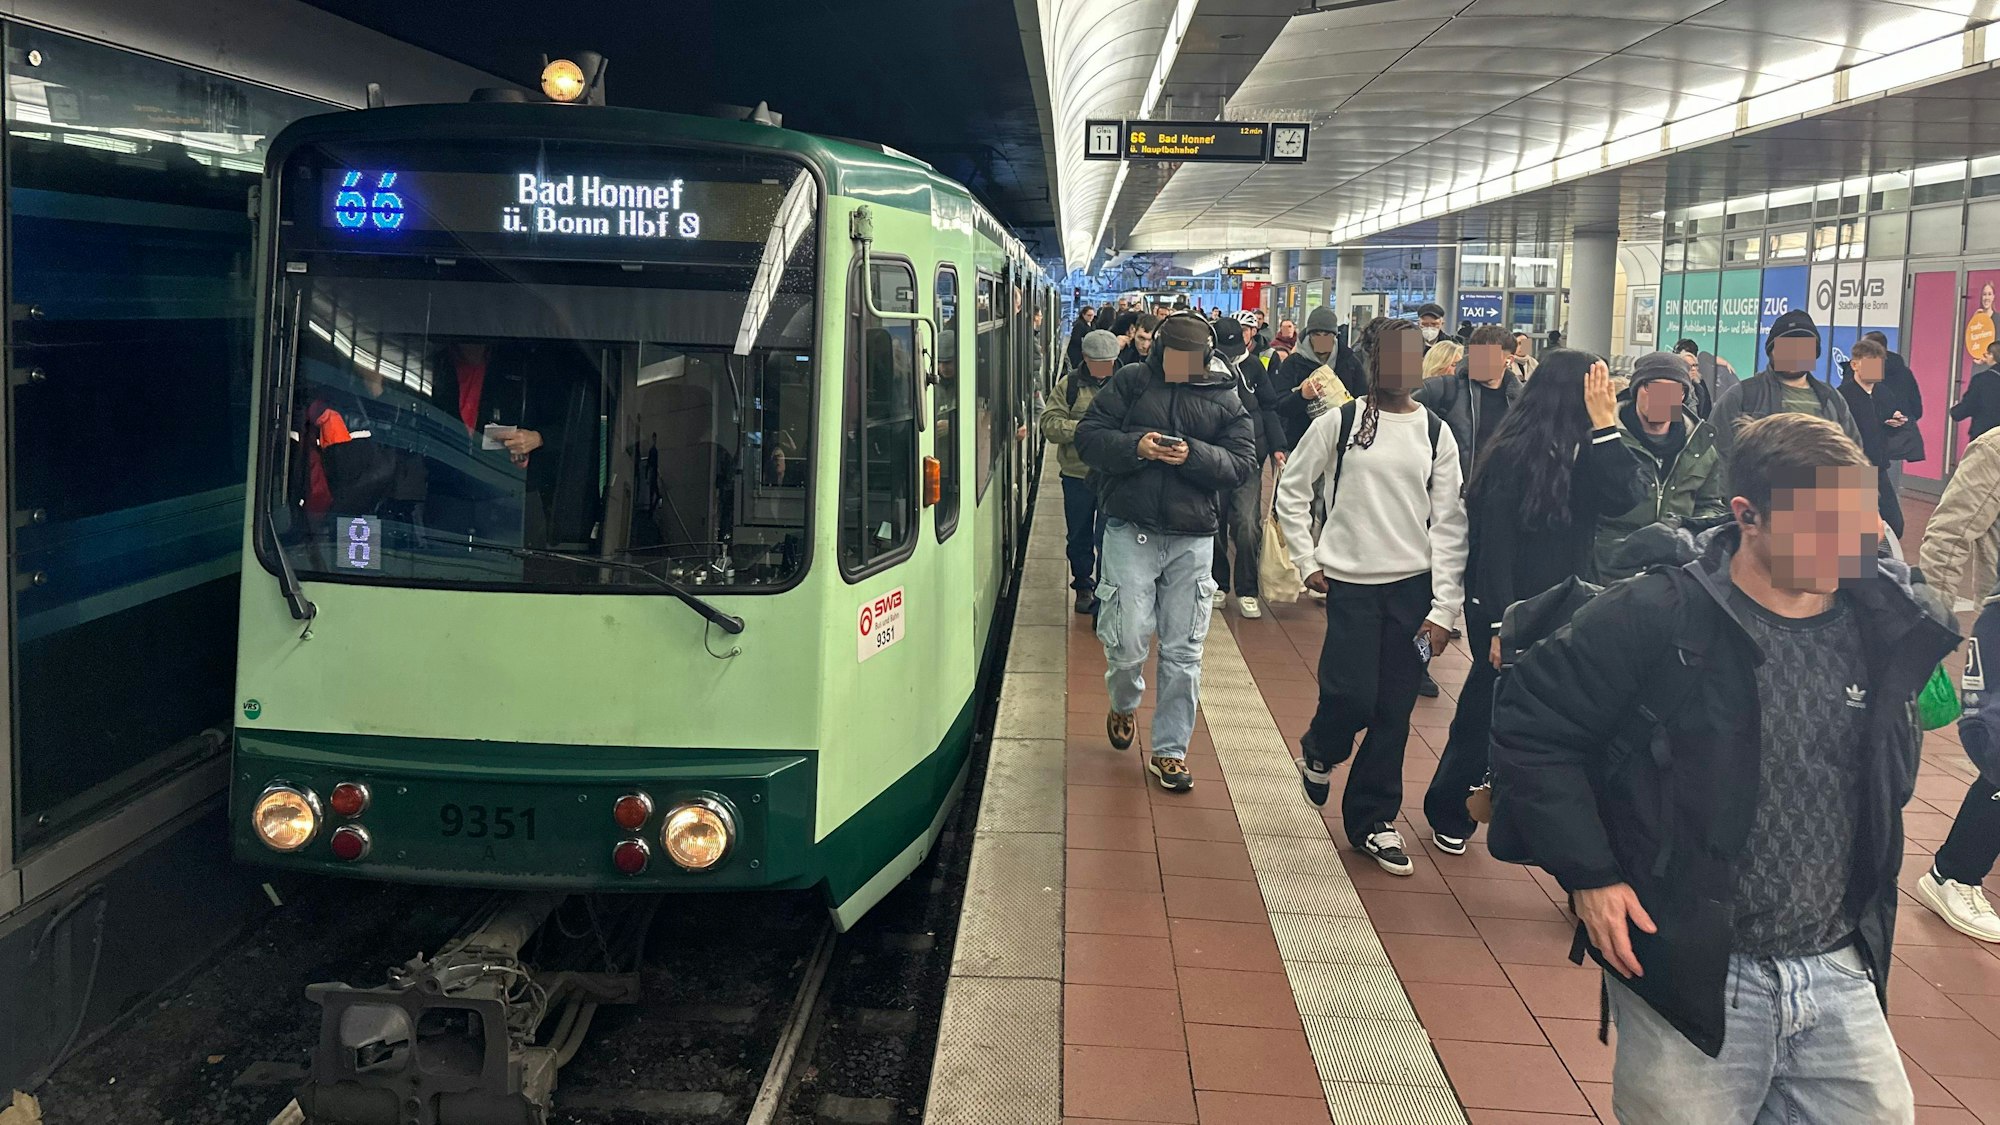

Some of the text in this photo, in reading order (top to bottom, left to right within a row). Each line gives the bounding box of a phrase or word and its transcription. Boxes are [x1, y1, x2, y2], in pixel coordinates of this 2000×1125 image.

[1096, 136, 1111, 150] 11
[1130, 131, 1215, 145] 66 Bad Honnef
[1141, 146, 1199, 155] Hauptbahnhof
[336, 170, 683, 229] 66 Bad Honnef
[502, 207, 527, 232] ü.
[537, 210, 609, 236] Bonn
[618, 212, 669, 237] Hbf
[1840, 278, 1884, 297] SWB
[1462, 306, 1484, 317] TAXI
[1665, 297, 1788, 315] EIN RICHTIG KLUGER ZUG
[1872, 301, 1888, 310] Bonn
[875, 591, 901, 618] SWB
[877, 626, 895, 648] 9351
[243, 702, 257, 710] VRS
[440, 803, 535, 840] 9351
[482, 845, 496, 861] A
